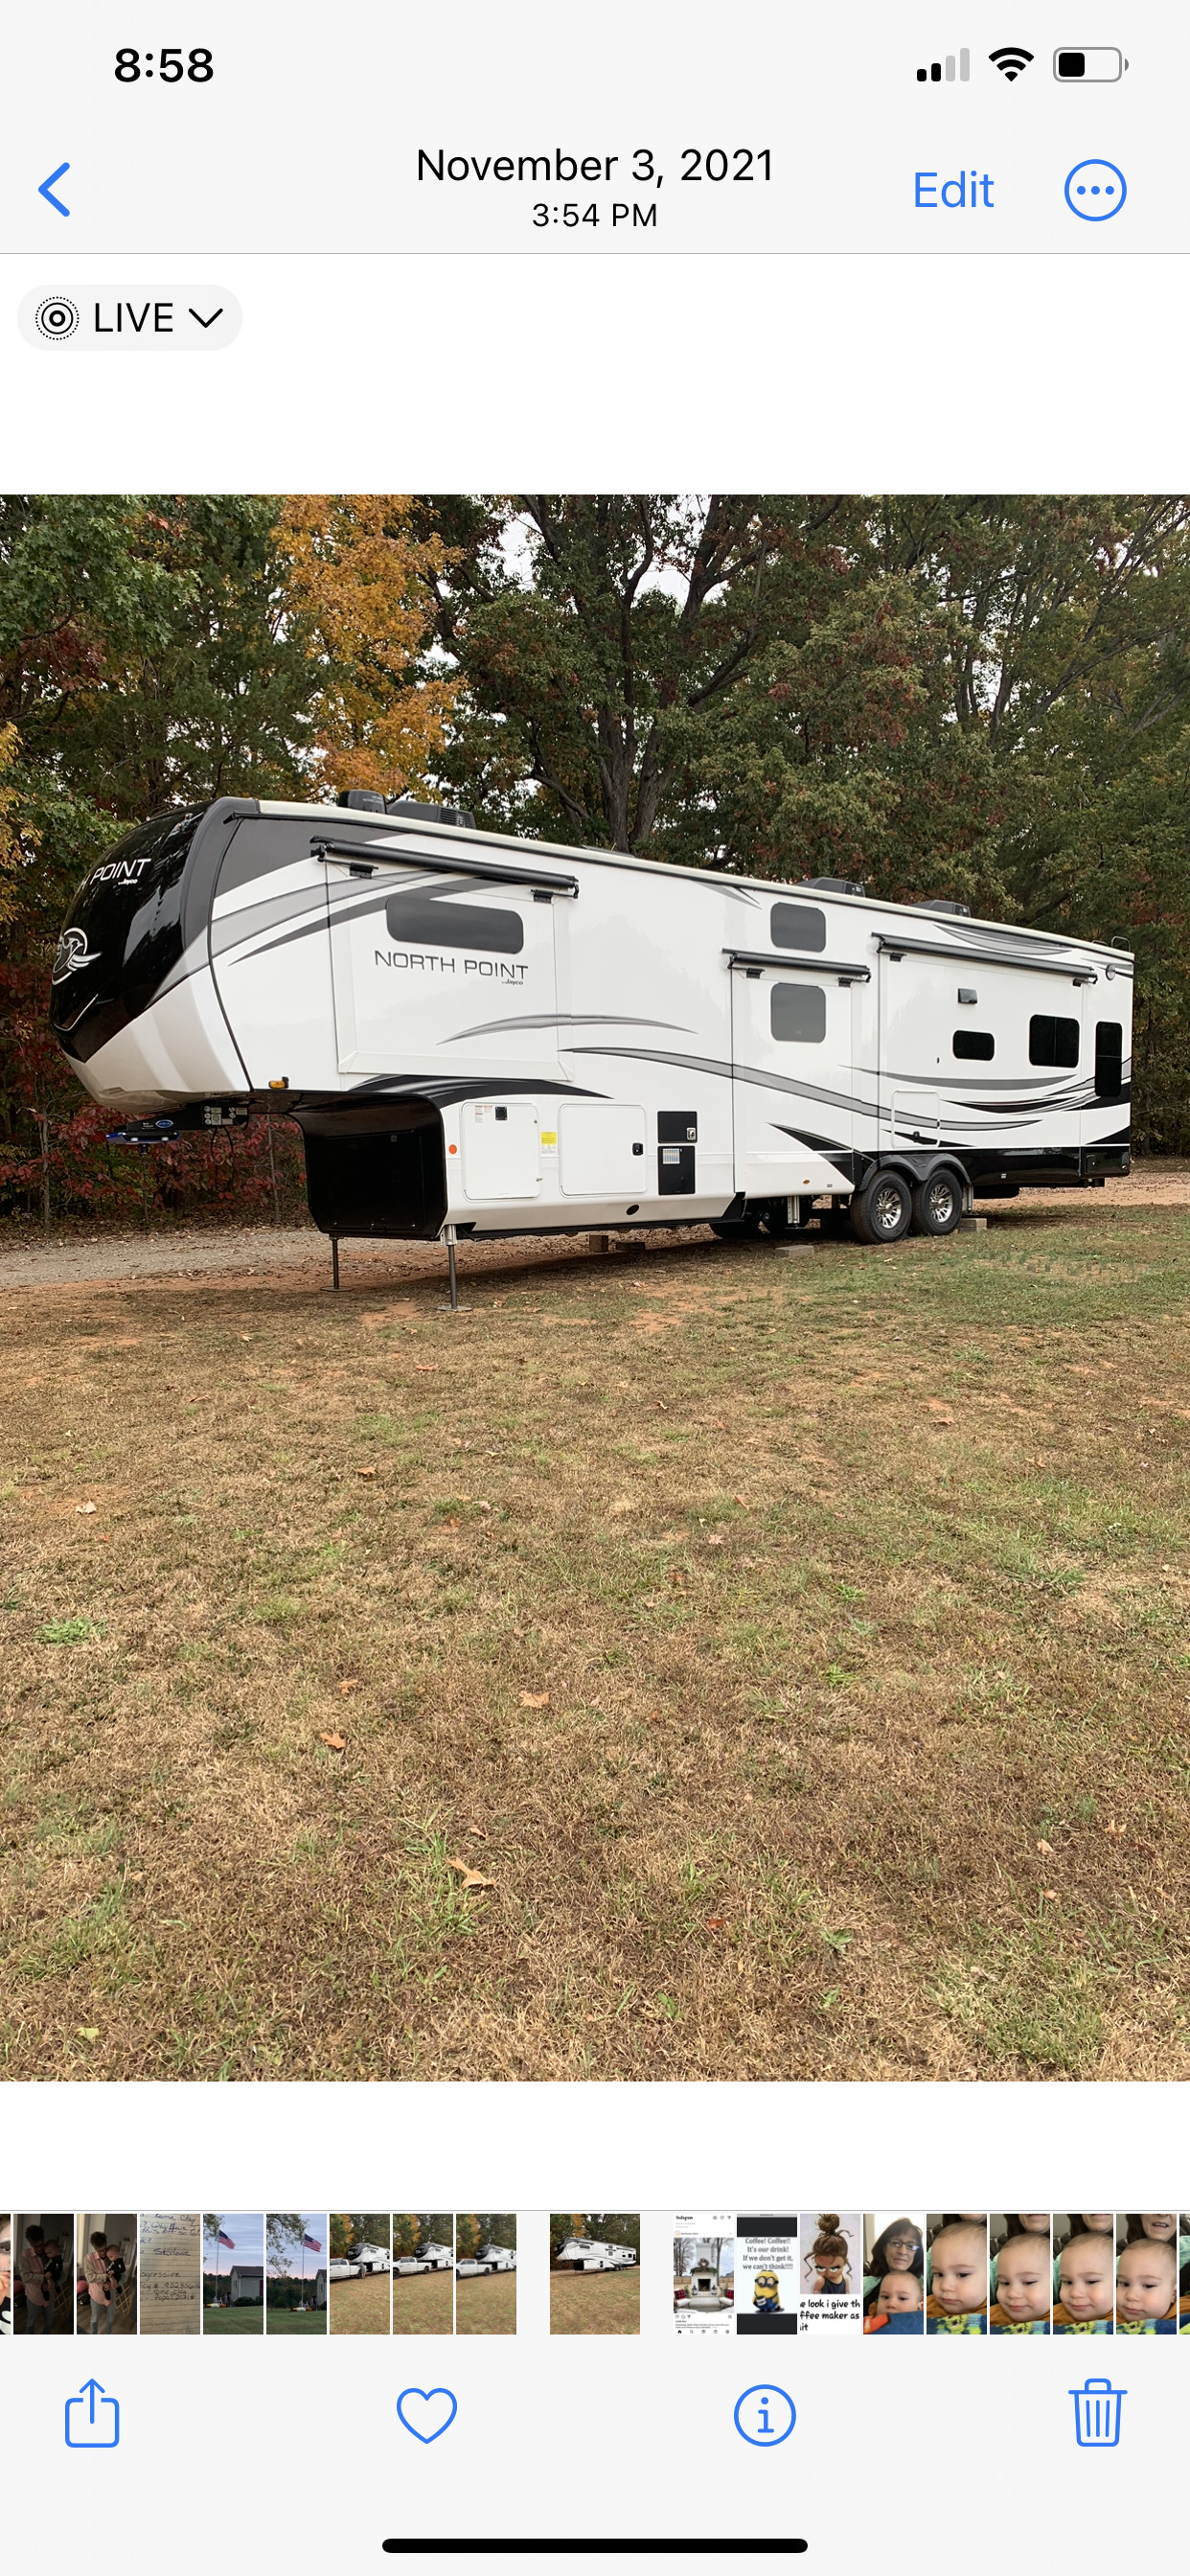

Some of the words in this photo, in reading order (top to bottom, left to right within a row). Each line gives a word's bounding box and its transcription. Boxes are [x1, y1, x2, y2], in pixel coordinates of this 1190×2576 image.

[114, 47, 215, 83] 8:58
[418, 148, 619, 182] November
[631, 149, 664, 189] 3,
[680, 148, 771, 182] 2021
[914, 170, 995, 209] Edit
[532, 202, 601, 228] 3:54
[612, 202, 657, 227] PM
[95, 302, 173, 333] LIVE
[89, 859, 151, 885] POINT
[375, 950, 455, 973] NORTH
[464, 959, 529, 979] POINT
[809, 2299, 824, 2308] look
[832, 2299, 848, 2310] give
[822, 2311, 848, 2319] maker
